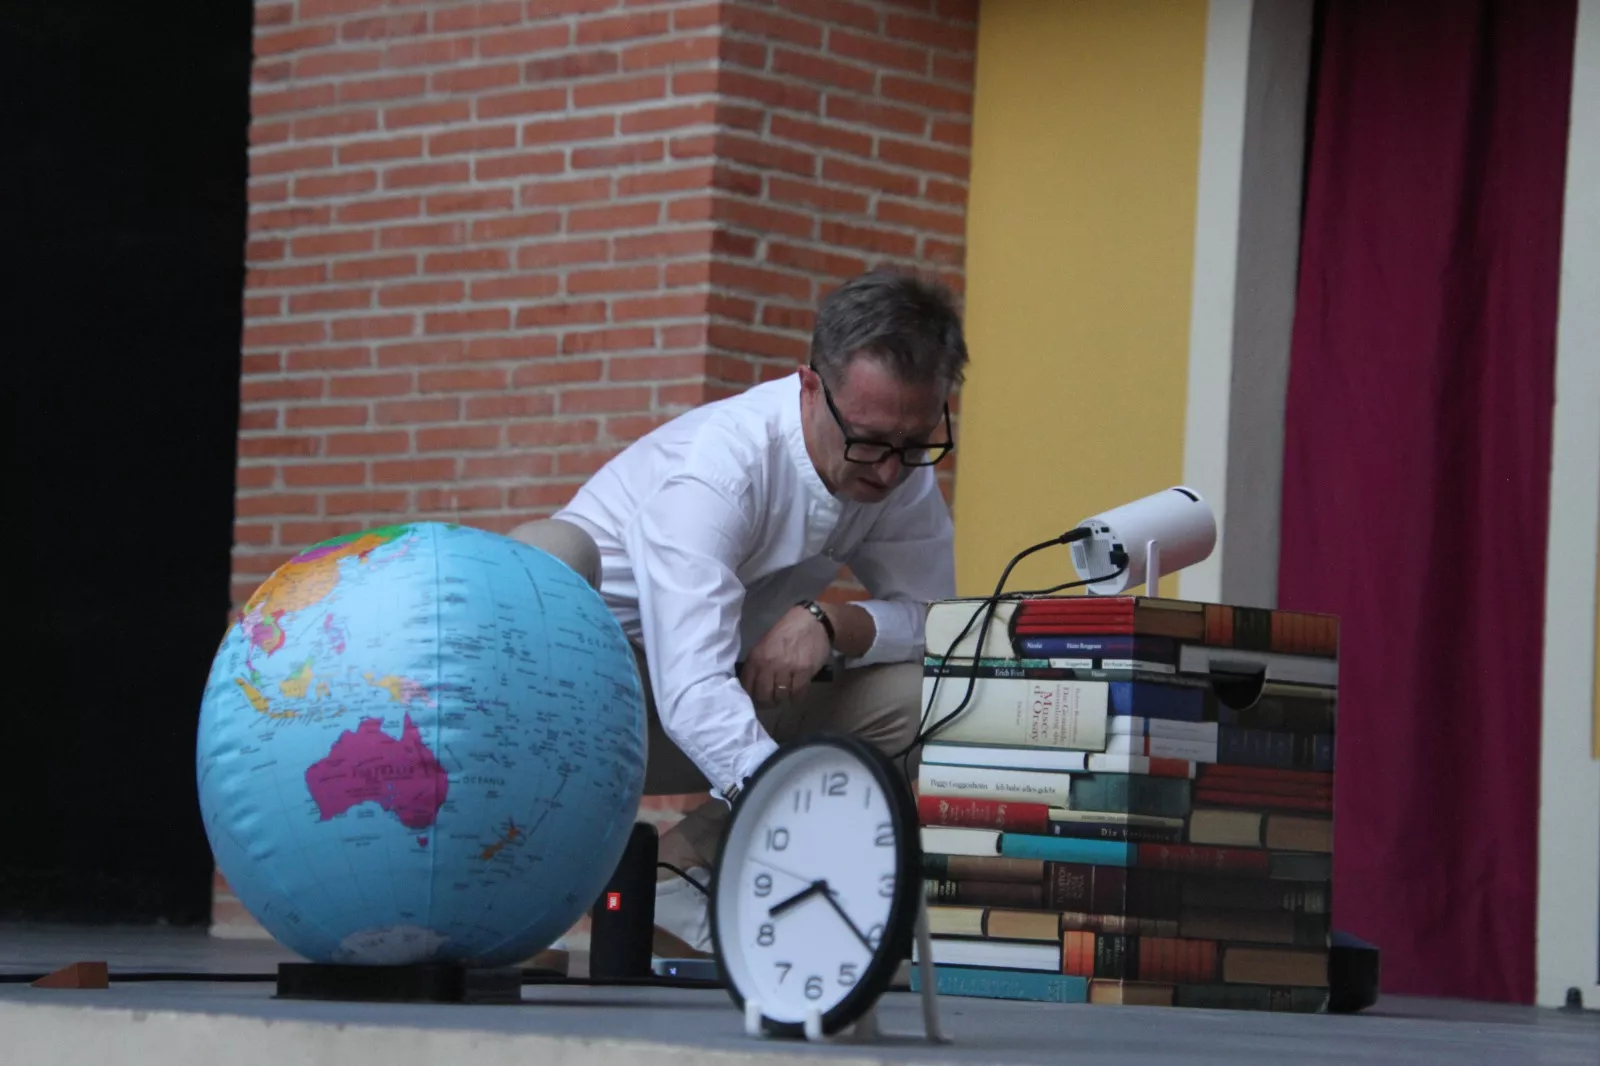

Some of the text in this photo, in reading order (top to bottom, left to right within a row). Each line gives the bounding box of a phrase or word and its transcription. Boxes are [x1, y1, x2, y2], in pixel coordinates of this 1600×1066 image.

[821, 773, 848, 797] 12
[793, 789, 811, 813] 11
[865, 787, 871, 809] 1
[766, 828, 789, 851] 10
[874, 824, 895, 847] 2
[754, 874, 773, 898] 9
[879, 875, 895, 898] 3
[756, 923, 775, 947] 8
[775, 963, 792, 985] 7
[837, 963, 858, 987] 5
[804, 976, 824, 1000] 6
